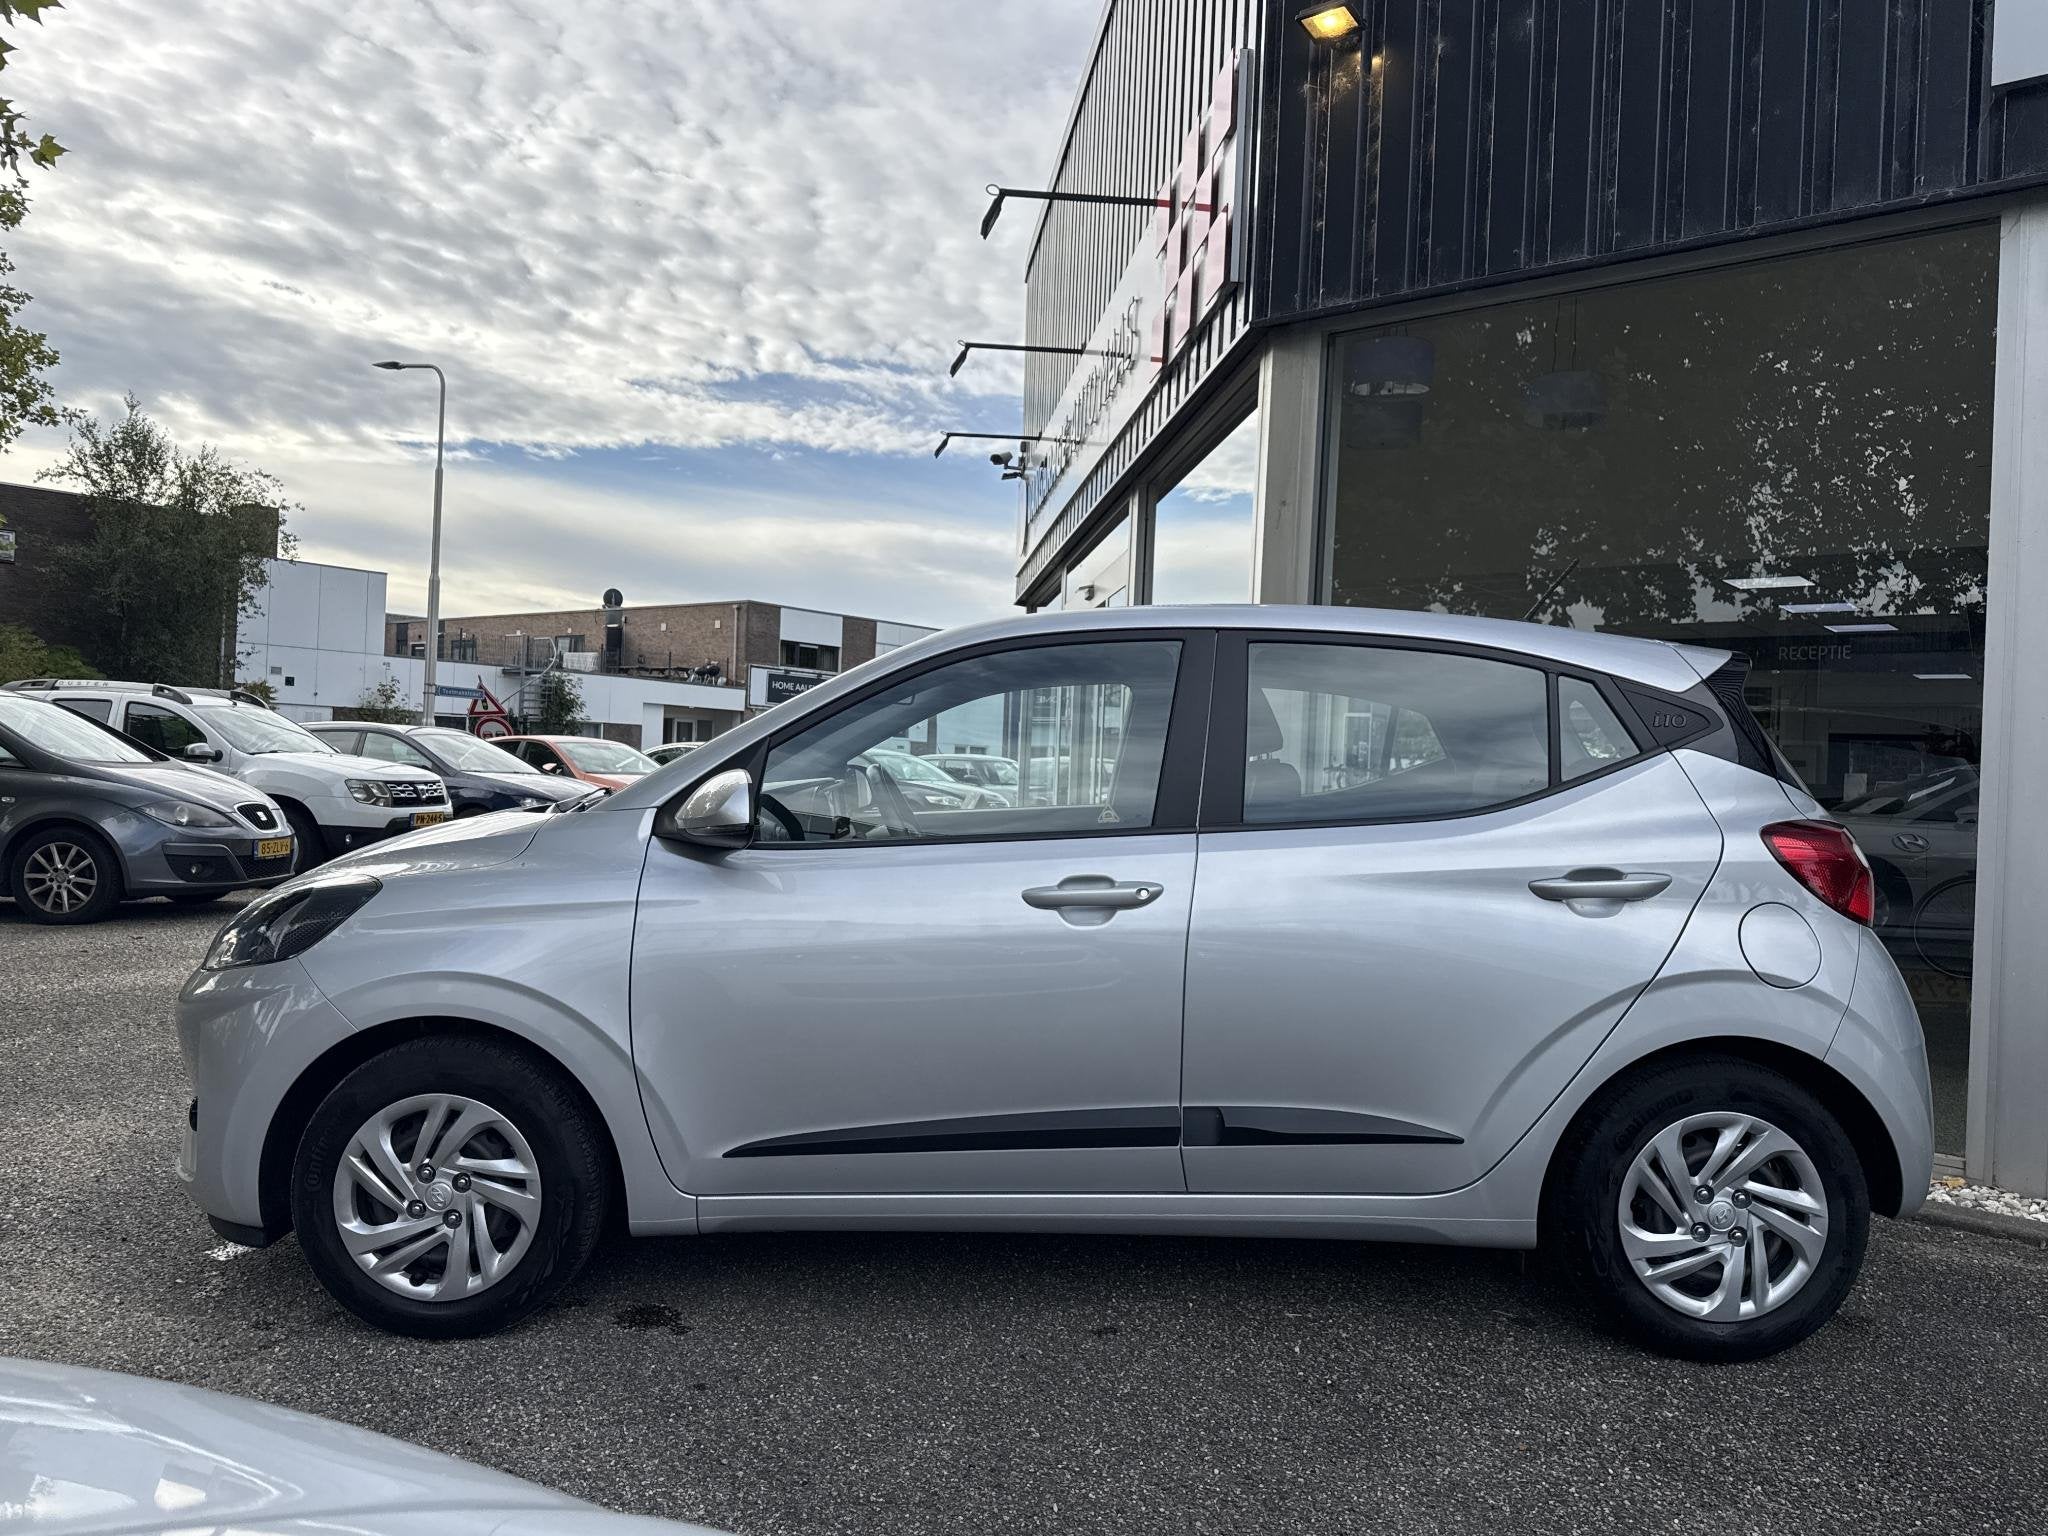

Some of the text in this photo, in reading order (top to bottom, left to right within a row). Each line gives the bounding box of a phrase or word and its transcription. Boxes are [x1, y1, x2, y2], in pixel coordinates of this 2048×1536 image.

[1779, 645, 1852, 660] RECEPTIE
[772, 681, 816, 692] HOME AALS
[1653, 711, 1687, 728] i10
